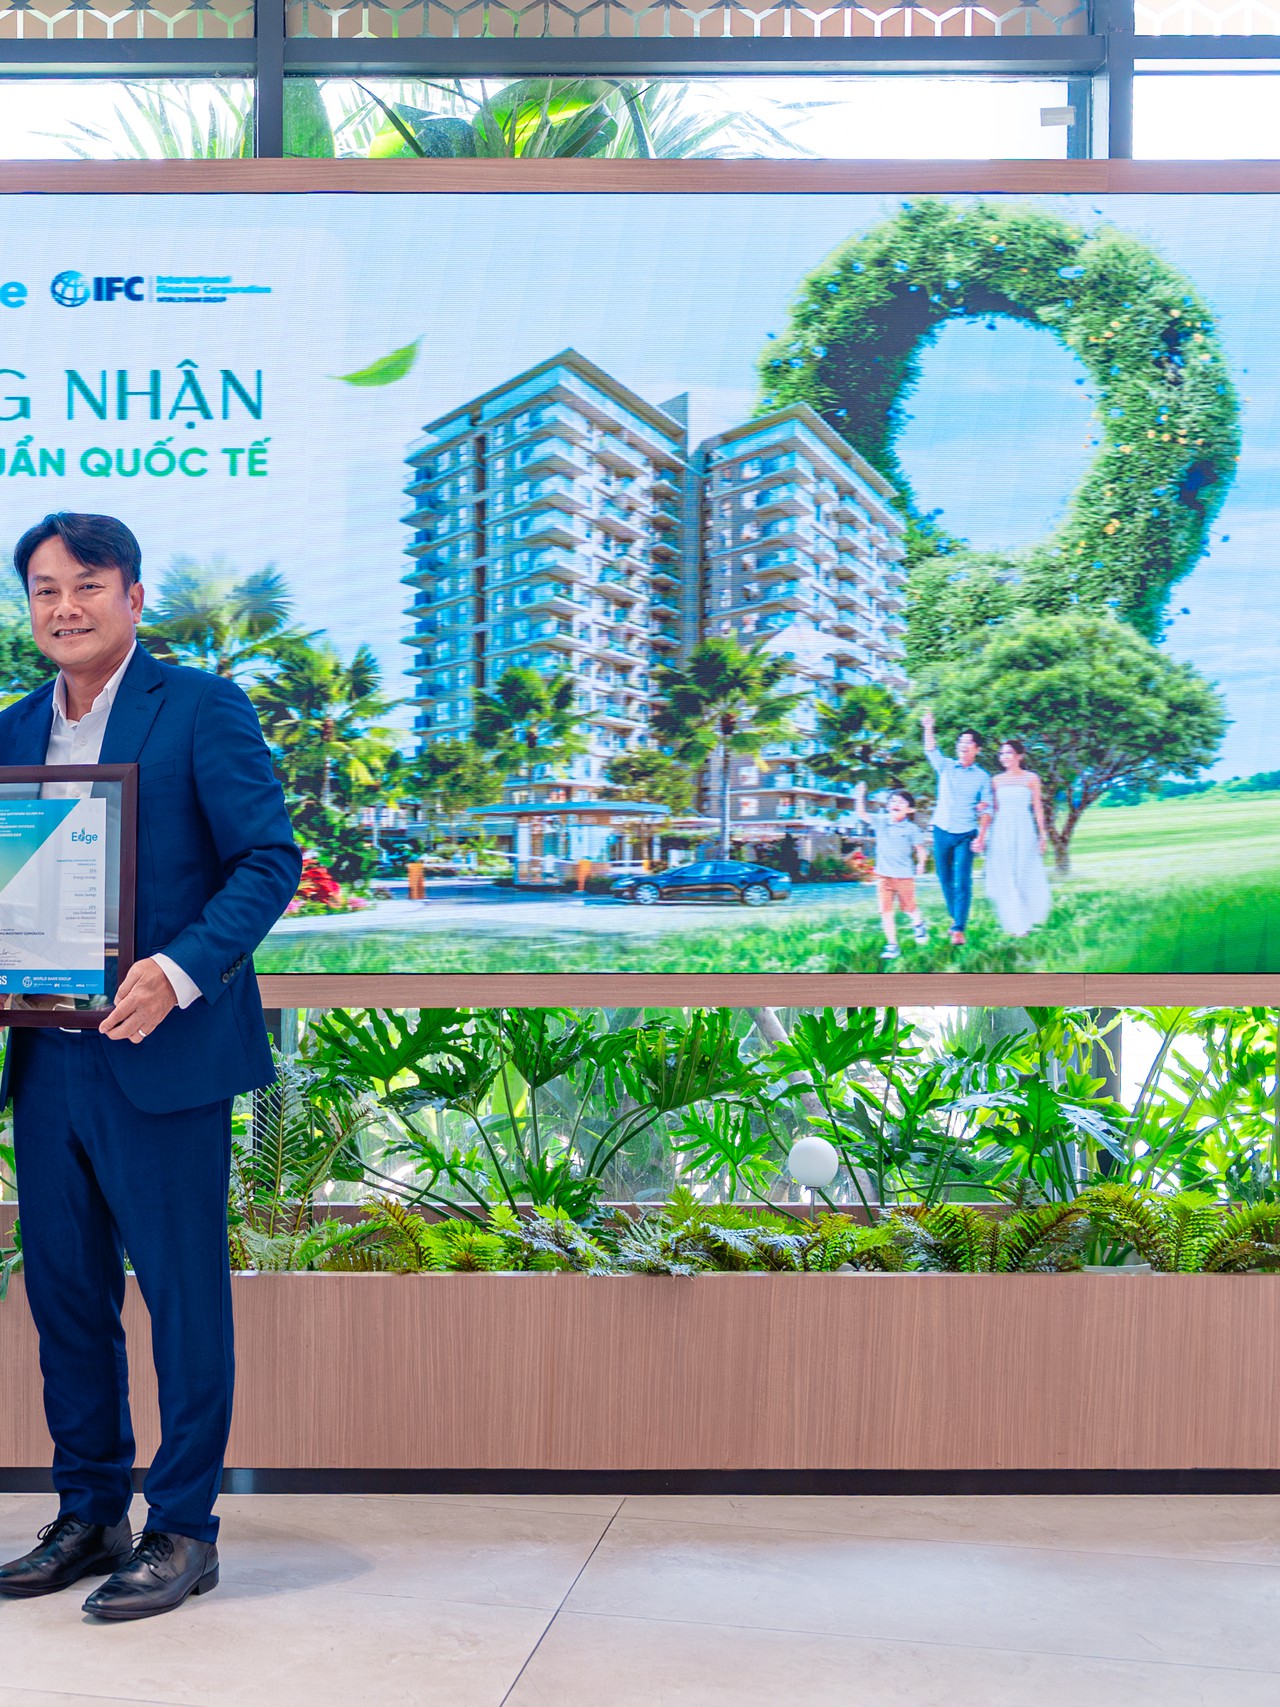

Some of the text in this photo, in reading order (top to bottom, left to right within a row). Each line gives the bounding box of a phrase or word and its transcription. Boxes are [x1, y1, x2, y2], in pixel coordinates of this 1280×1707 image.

[92, 275, 145, 302] IFC
[64, 358, 264, 430] NHẬN
[79, 436, 209, 479] QUỐC
[221, 437, 272, 478] TẾ
[71, 827, 98, 844] Edge
